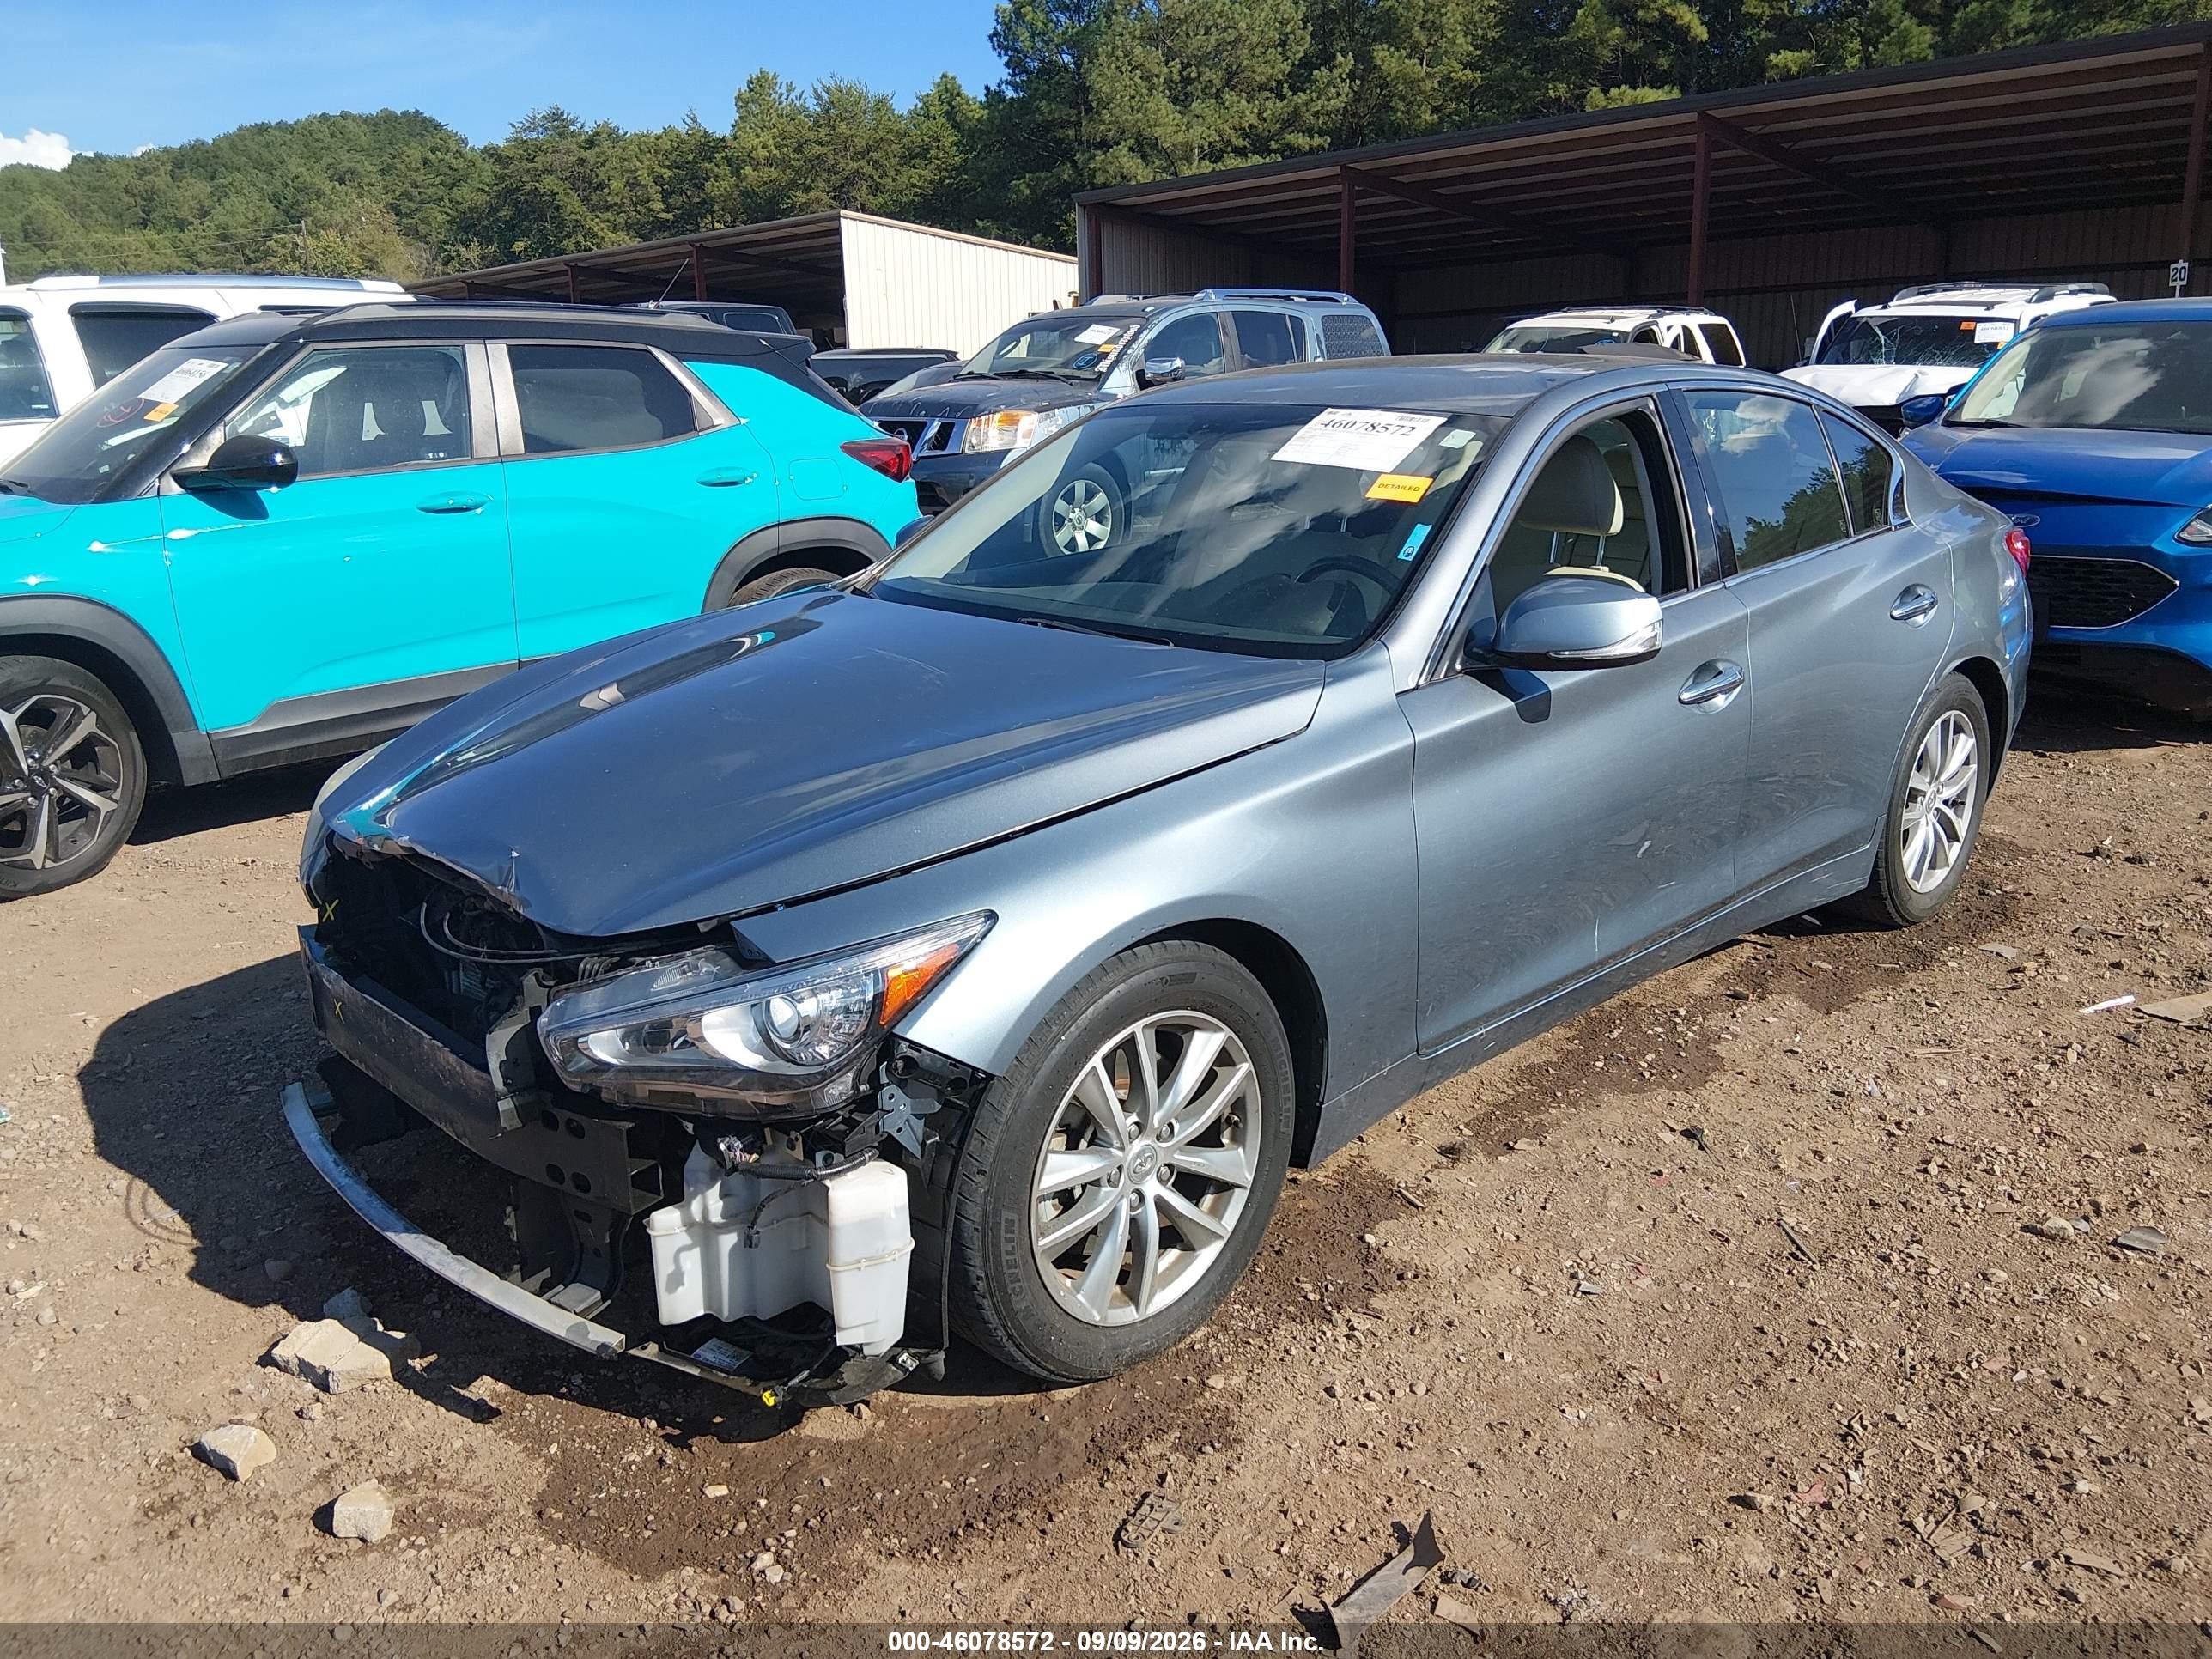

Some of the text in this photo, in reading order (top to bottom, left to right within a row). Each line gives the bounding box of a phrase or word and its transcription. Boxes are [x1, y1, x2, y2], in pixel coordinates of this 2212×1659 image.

[2171, 266, 2186, 283] 20
[1320, 418, 1416, 436] 46078572
[1377, 483, 1421, 492] DETAILED
